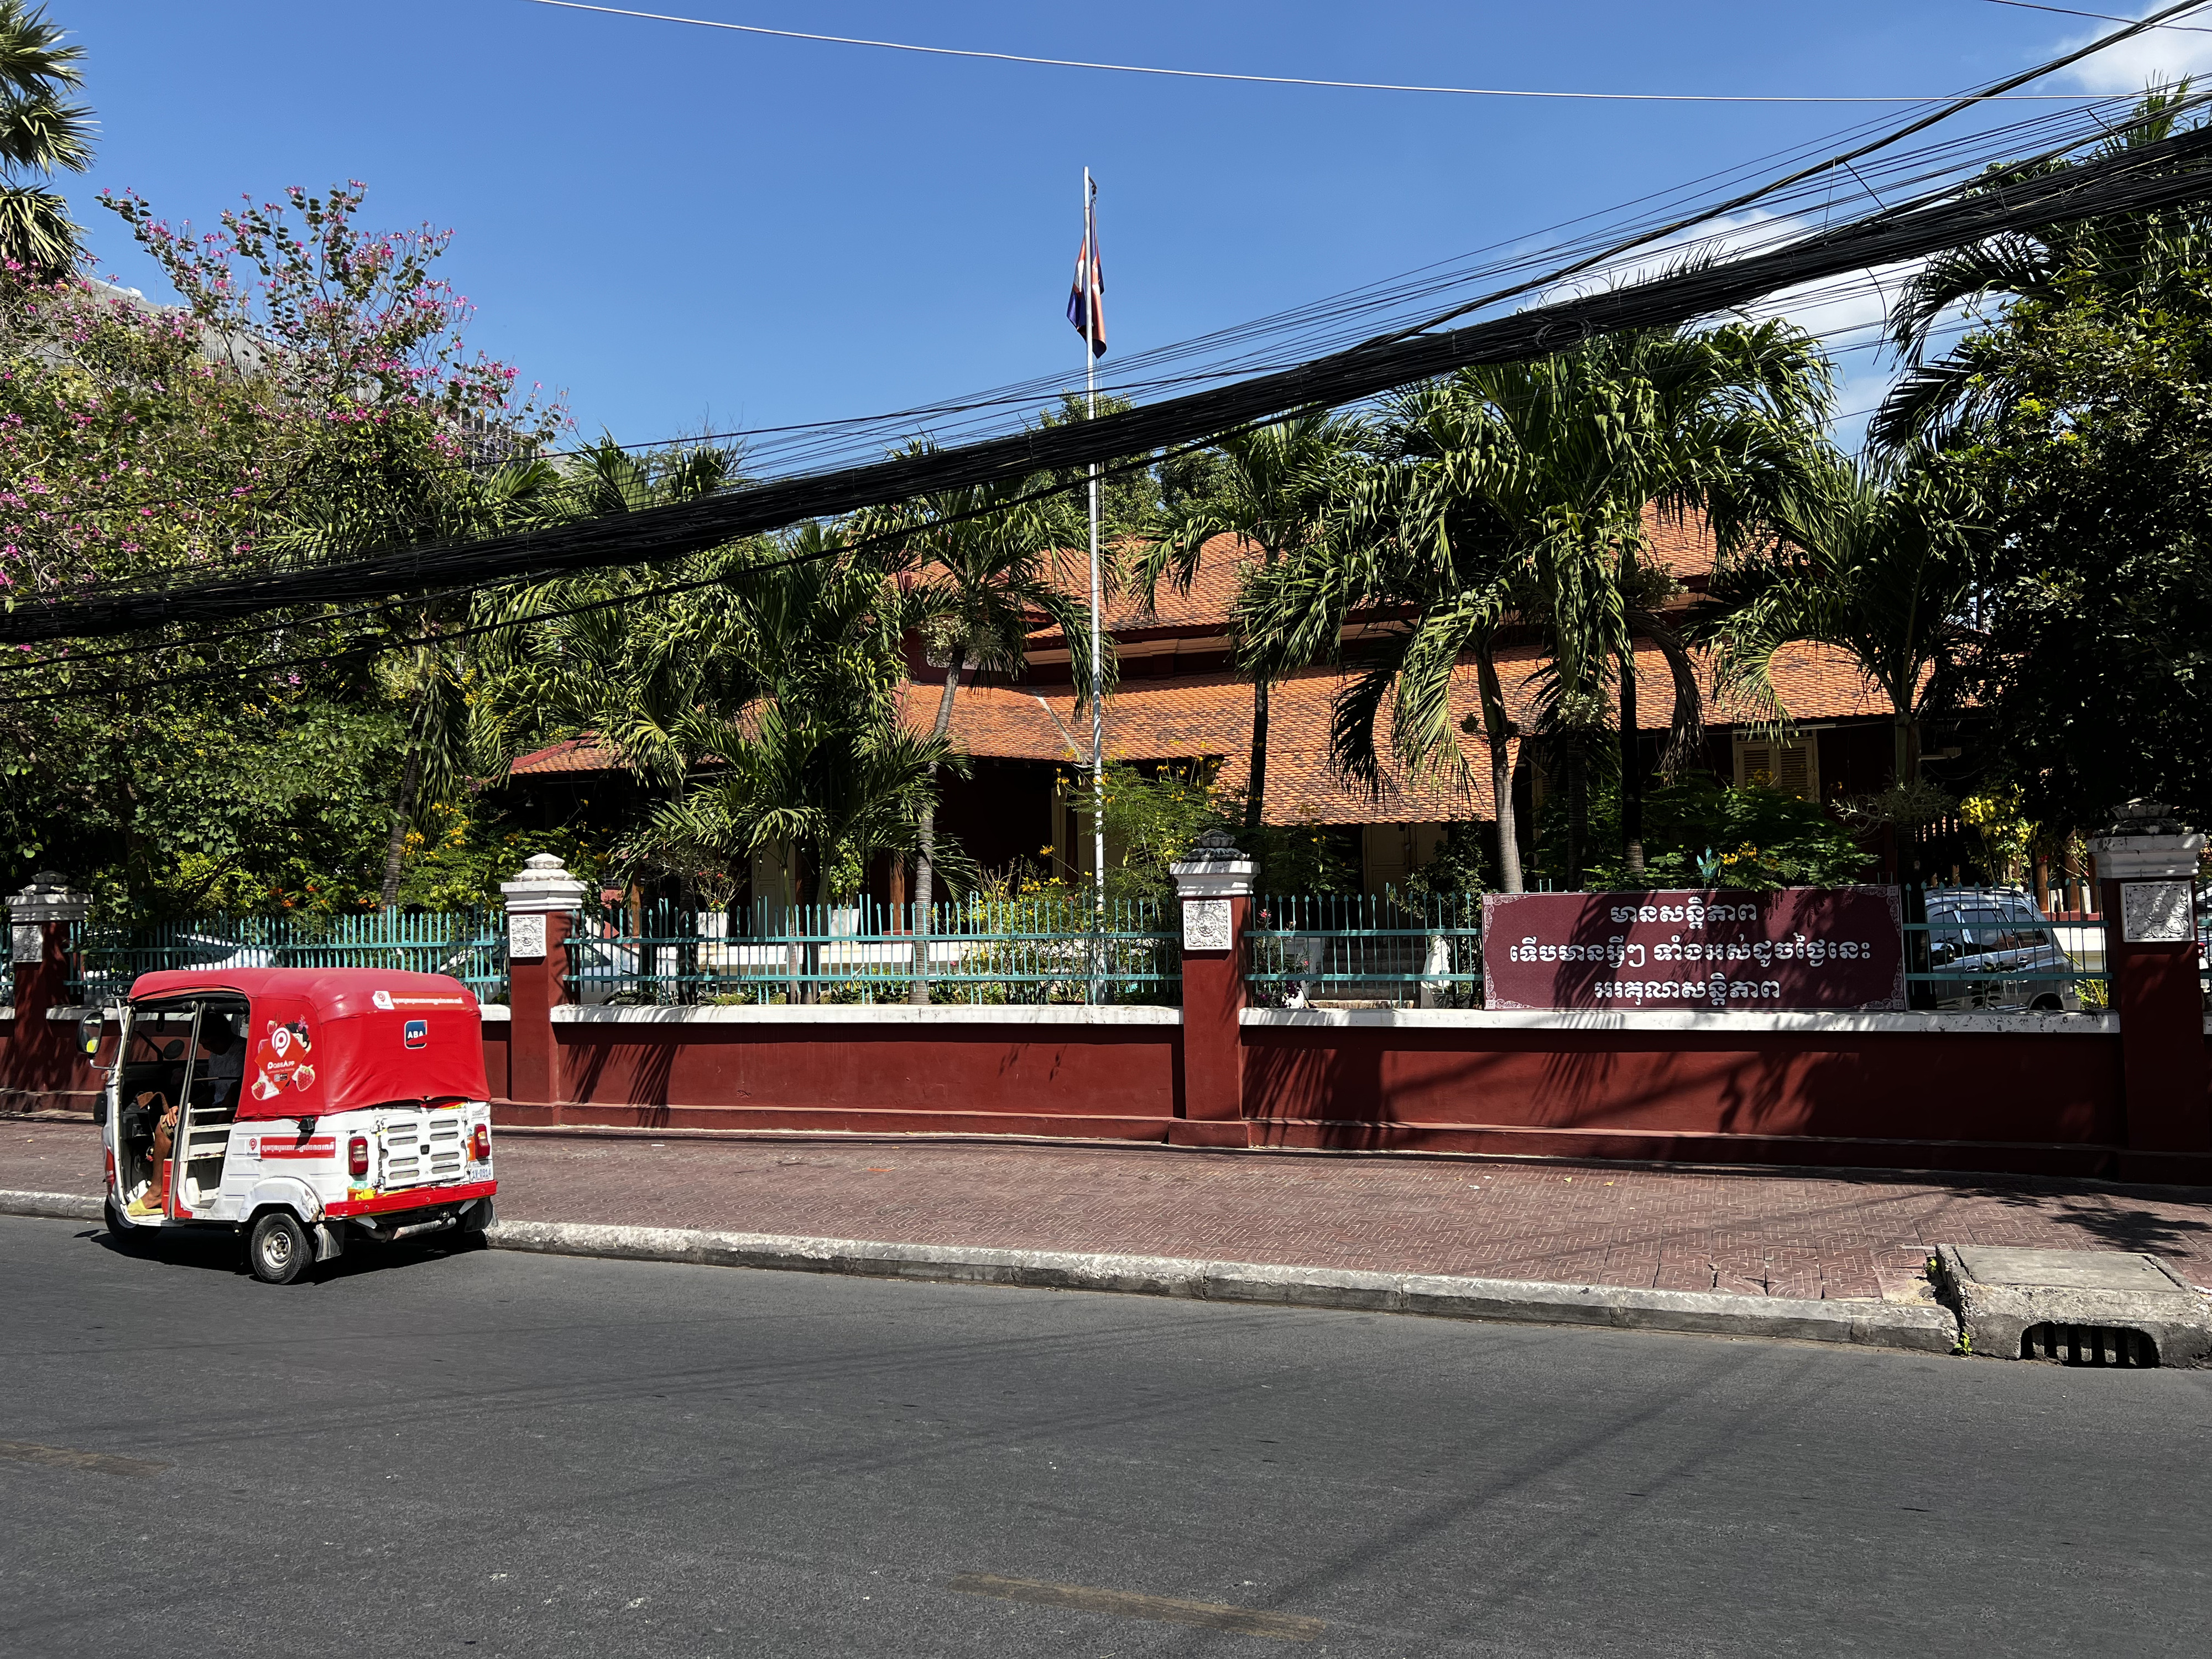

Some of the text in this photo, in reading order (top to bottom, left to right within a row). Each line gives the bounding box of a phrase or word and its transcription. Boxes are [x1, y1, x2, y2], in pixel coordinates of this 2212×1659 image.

[1610, 896, 1757, 930] មានសន្តិភាព
[1510, 935, 1646, 968] ទើបមានអ្វីៗ
[1594, 972, 1780, 1006] អរគុណសន្តិភាព
